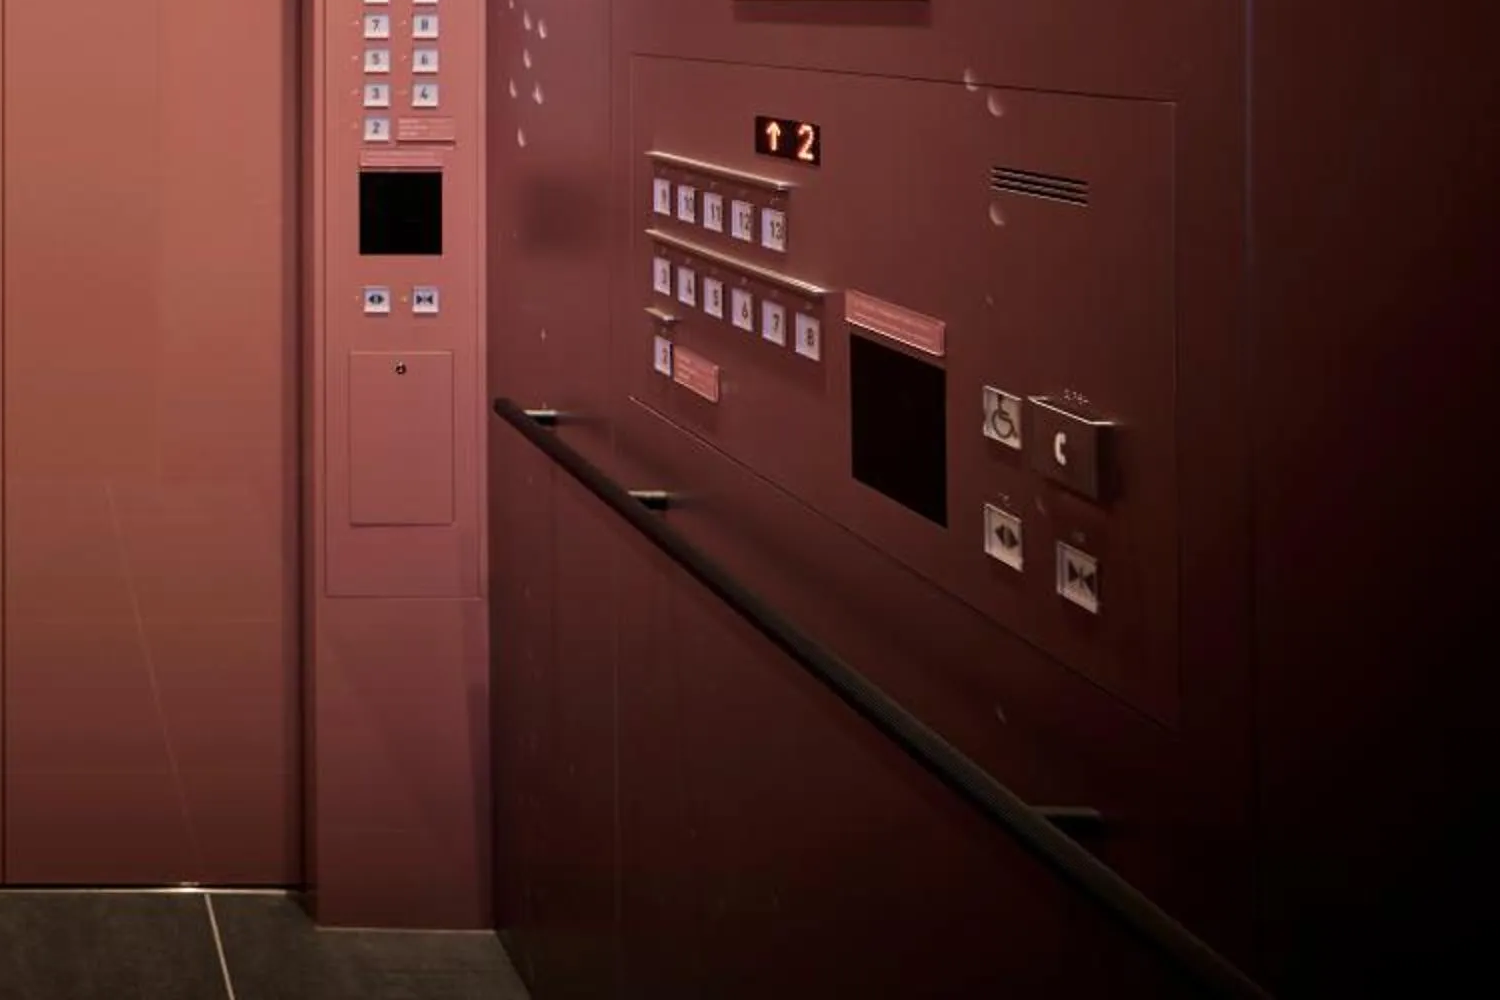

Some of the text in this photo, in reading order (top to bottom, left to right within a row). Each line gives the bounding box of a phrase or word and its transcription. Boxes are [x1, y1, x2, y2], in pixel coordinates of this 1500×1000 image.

[371, 18, 380, 32] 7
[372, 87, 380, 100] 3
[420, 86, 428, 100] 4
[372, 121, 380, 134] 2
[798, 123, 814, 161] 2
[770, 220, 784, 240] 13
[773, 313, 780, 332] 7
[806, 327, 815, 347] 8
